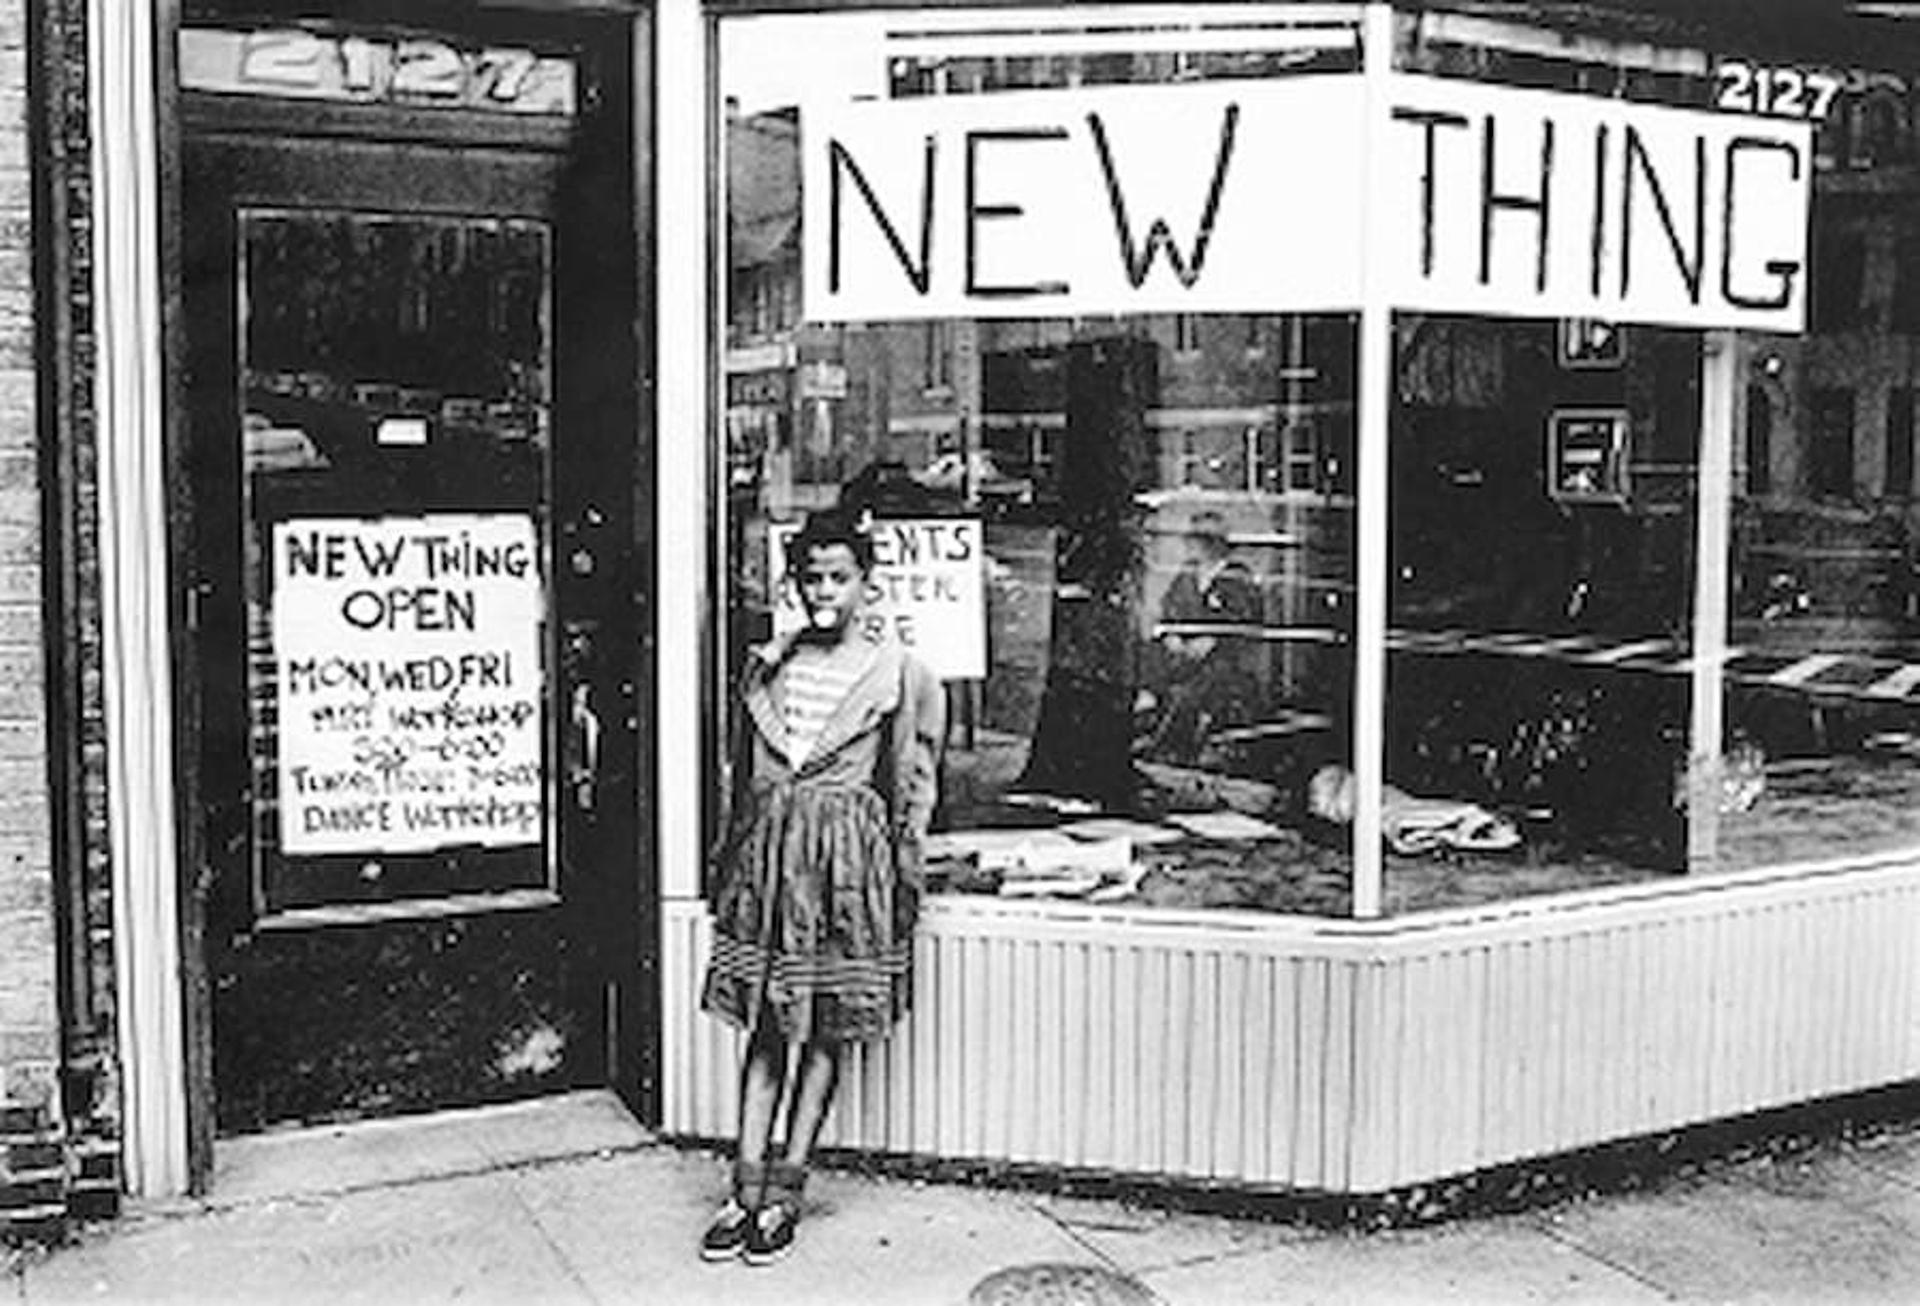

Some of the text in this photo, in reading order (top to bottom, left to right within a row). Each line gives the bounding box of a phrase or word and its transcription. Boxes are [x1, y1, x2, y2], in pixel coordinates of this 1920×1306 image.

[241, 29, 540, 101] 2127
[1715, 62, 1843, 119] 2127
[829, 103, 1801, 310] NEW THING
[286, 532, 405, 579] NEW
[341, 587, 475, 631] OPEN
